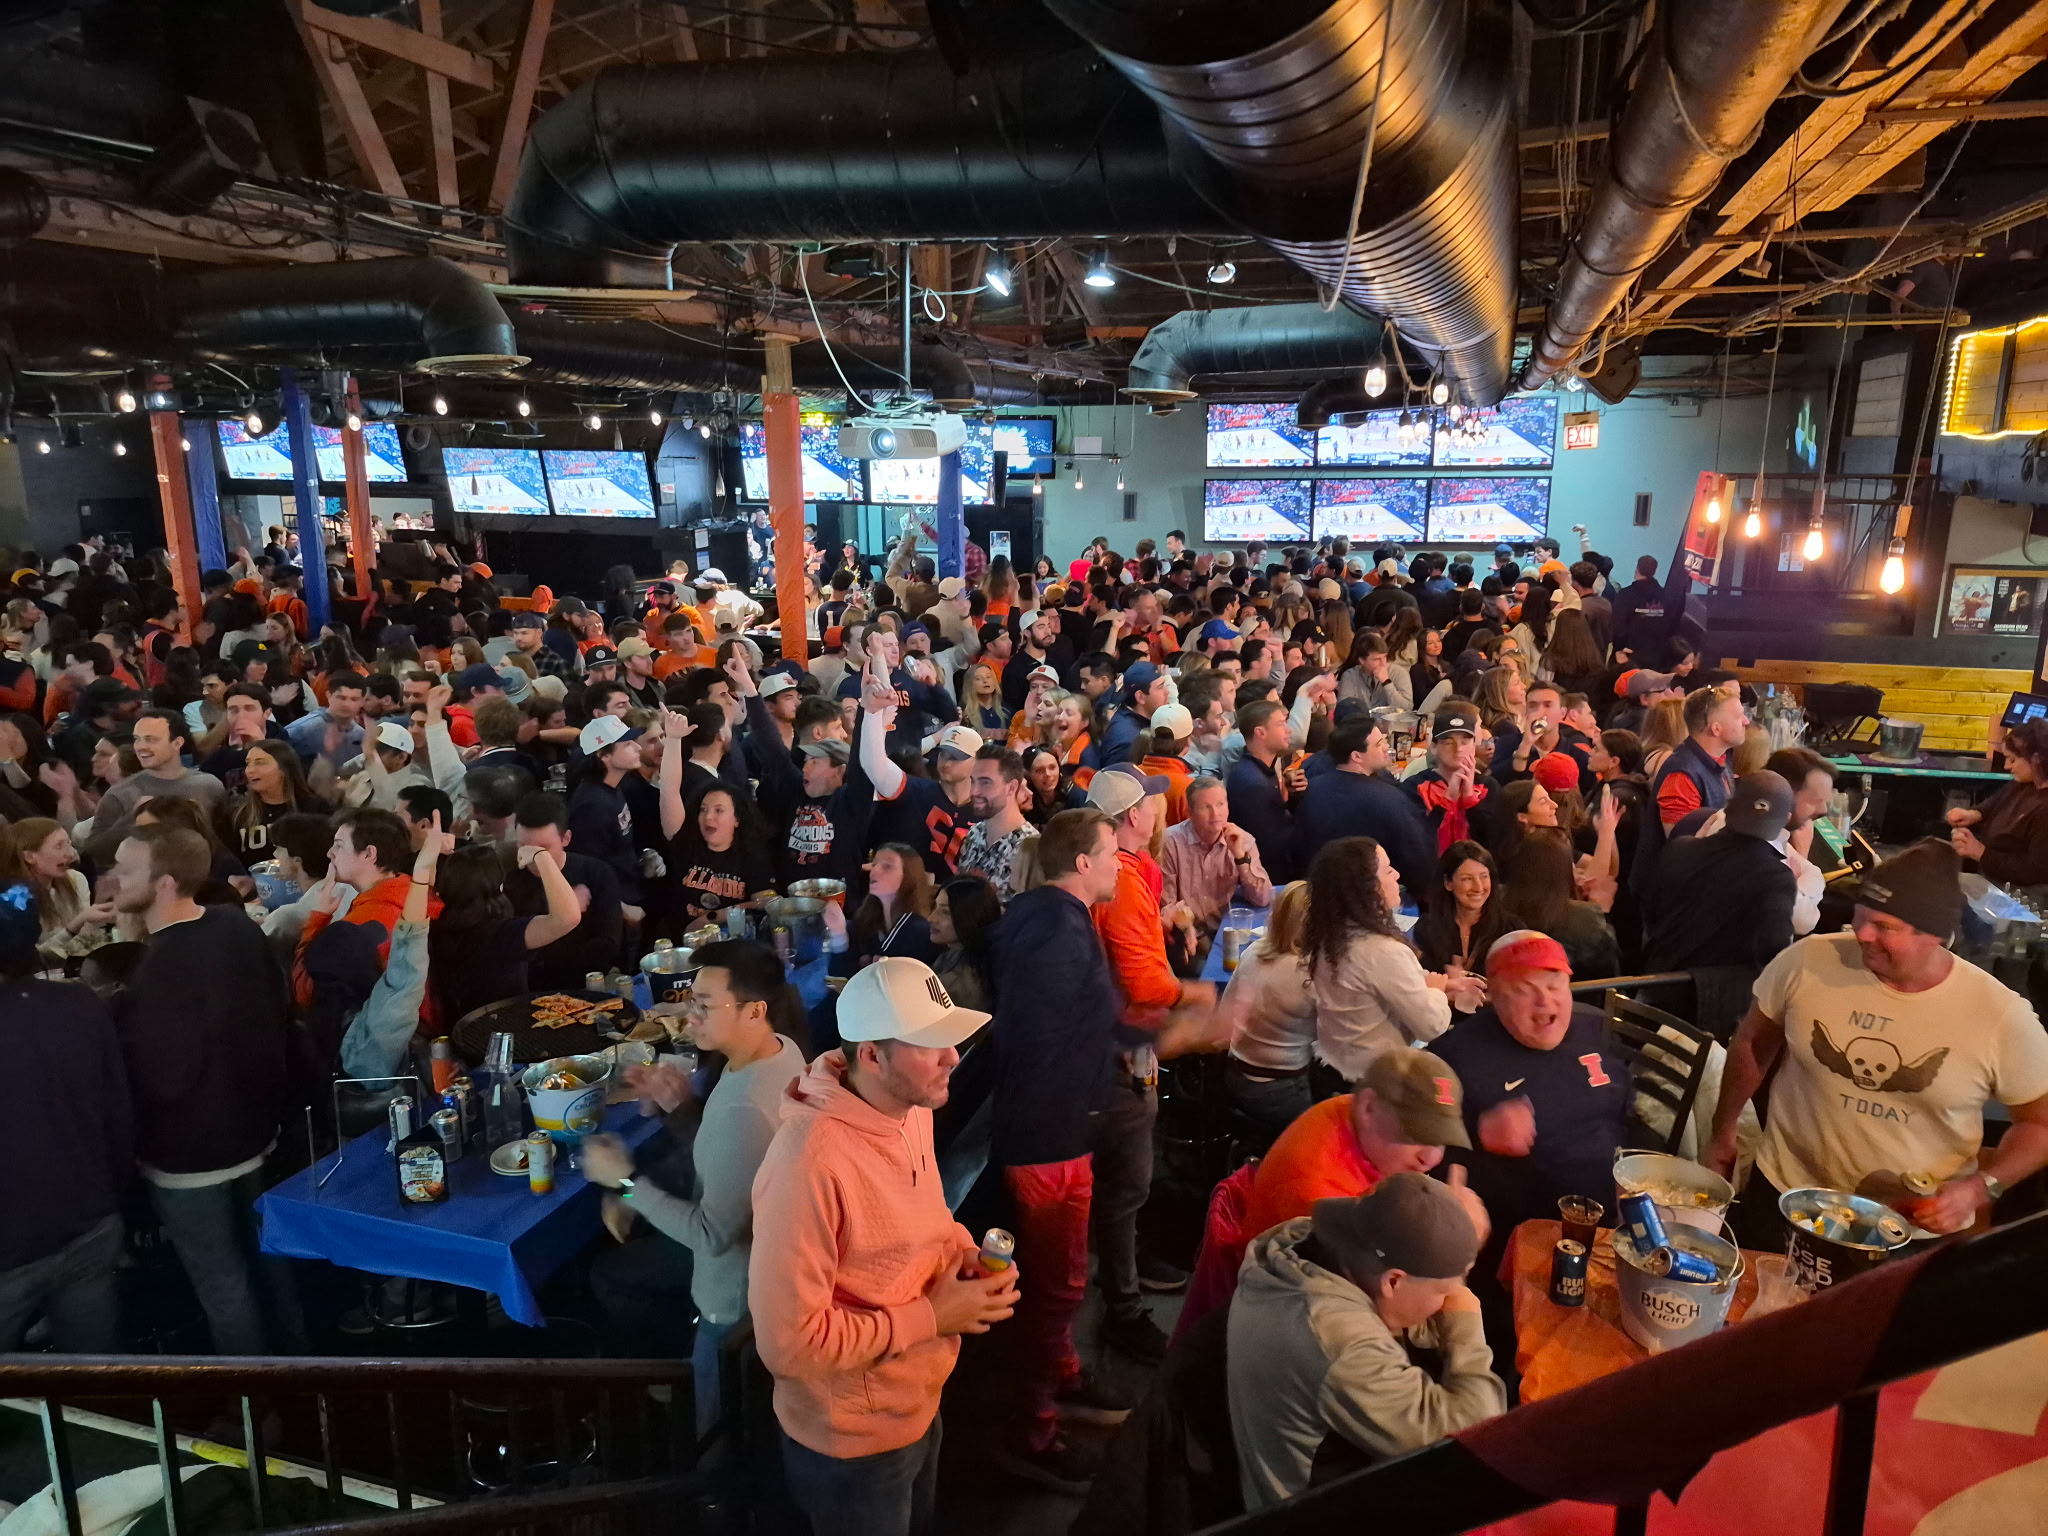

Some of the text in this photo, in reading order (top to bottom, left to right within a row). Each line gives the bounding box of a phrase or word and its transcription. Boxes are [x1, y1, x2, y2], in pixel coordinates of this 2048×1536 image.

[1567, 425, 1594, 443] EXIT
[673, 978, 692, 989] IT'S
[1848, 1010, 1894, 1032] NOT
[1840, 1093, 1917, 1124] TODAY
[1556, 1283, 1584, 1297] LIGH
[1641, 1291, 1700, 1318] BUSCH
[1651, 1310, 1686, 1325] LIGHT
